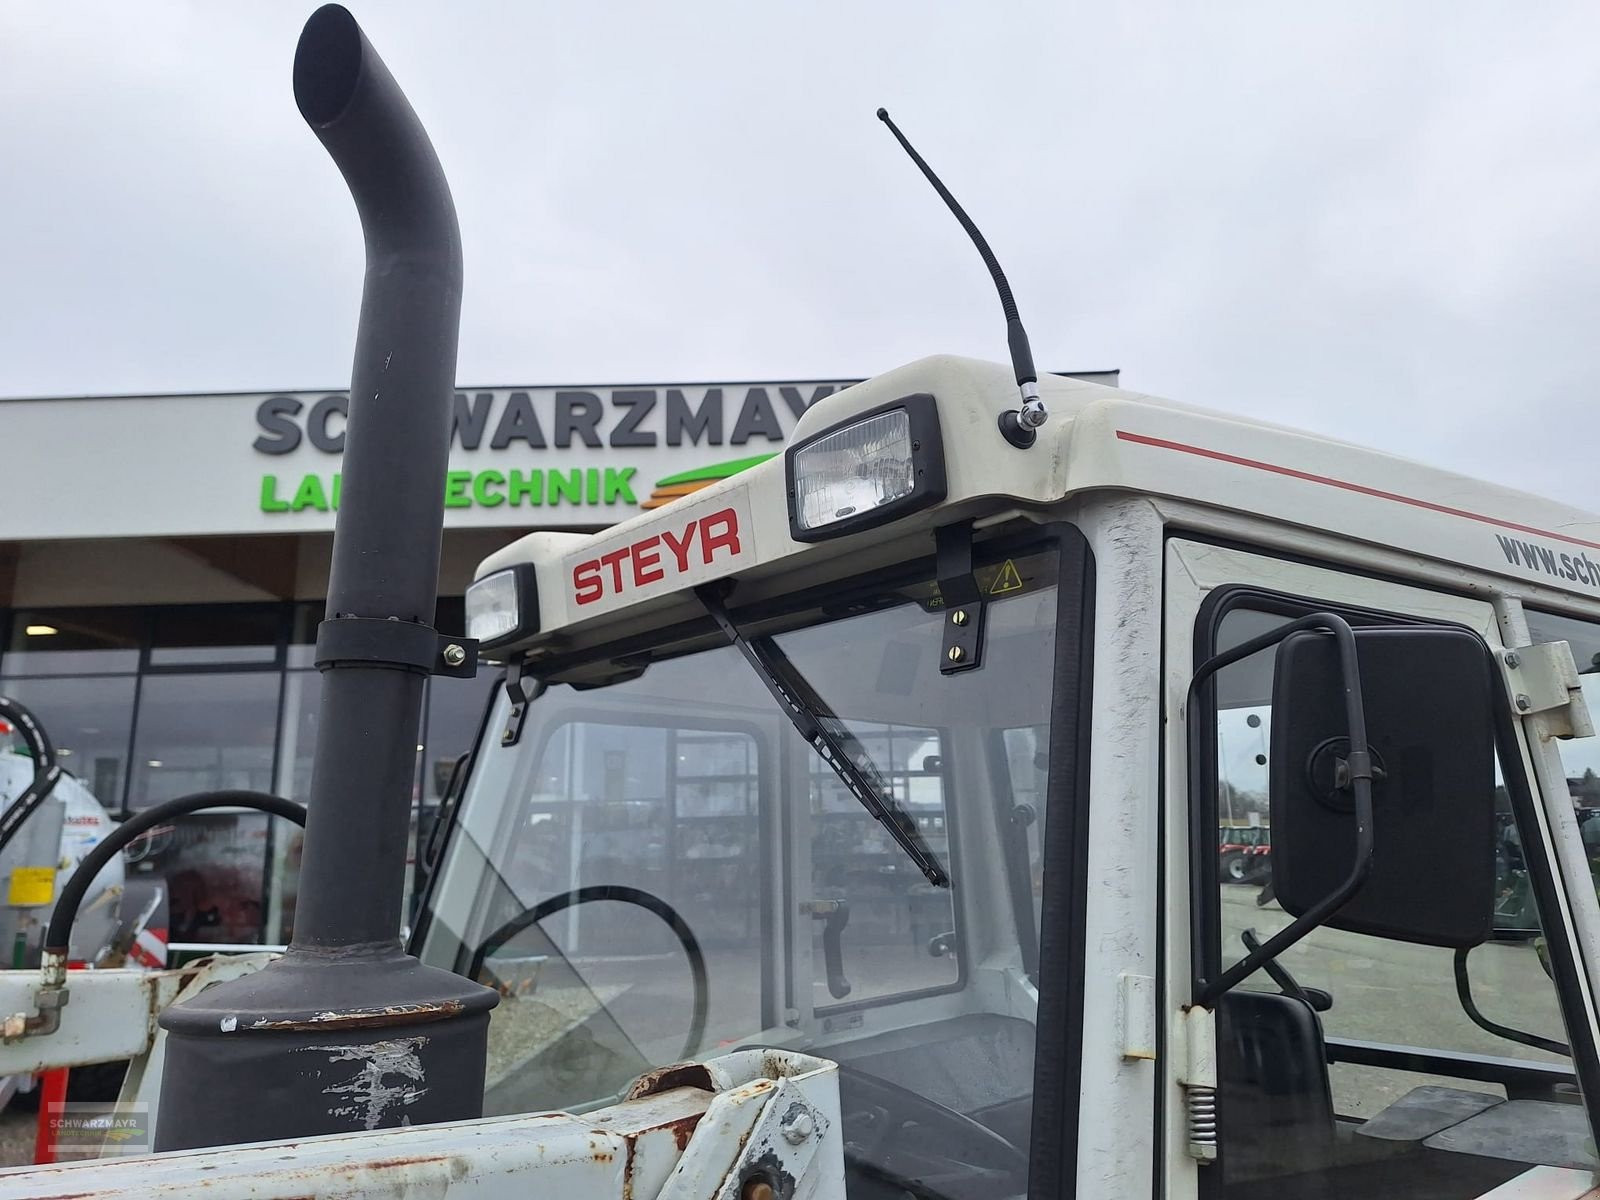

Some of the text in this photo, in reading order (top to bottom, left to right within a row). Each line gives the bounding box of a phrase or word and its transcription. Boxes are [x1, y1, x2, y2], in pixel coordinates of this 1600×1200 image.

[252, 386, 855, 455] SCWARZMAY
[260, 467, 638, 513] LAECHNIK
[573, 507, 741, 606] STEYR
[1495, 533, 1600, 587] www.sch
